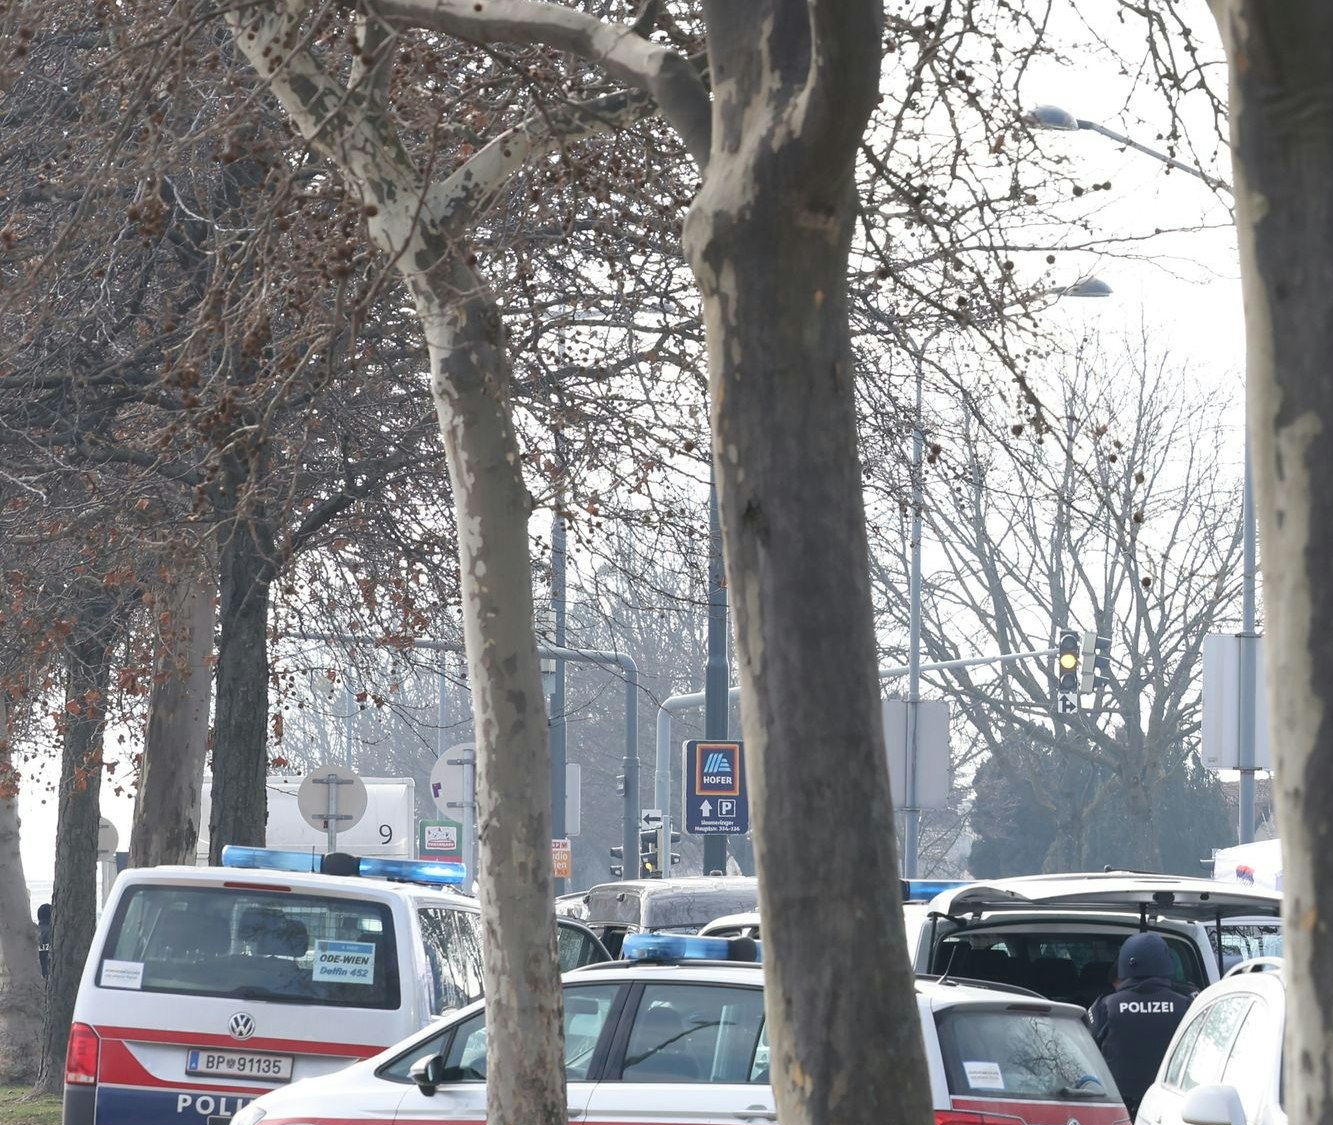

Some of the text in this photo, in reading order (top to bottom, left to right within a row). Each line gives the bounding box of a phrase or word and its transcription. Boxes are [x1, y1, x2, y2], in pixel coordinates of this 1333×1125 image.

[703, 776, 733, 785] HOFER
[379, 824, 393, 845] 9
[320, 954, 370, 965] ODE-WIEN
[349, 968, 369, 977] 452
[1119, 1001, 1174, 1013] POLIZEI
[205, 1054, 282, 1075] BP 91135
[177, 1094, 256, 1116] POLI
